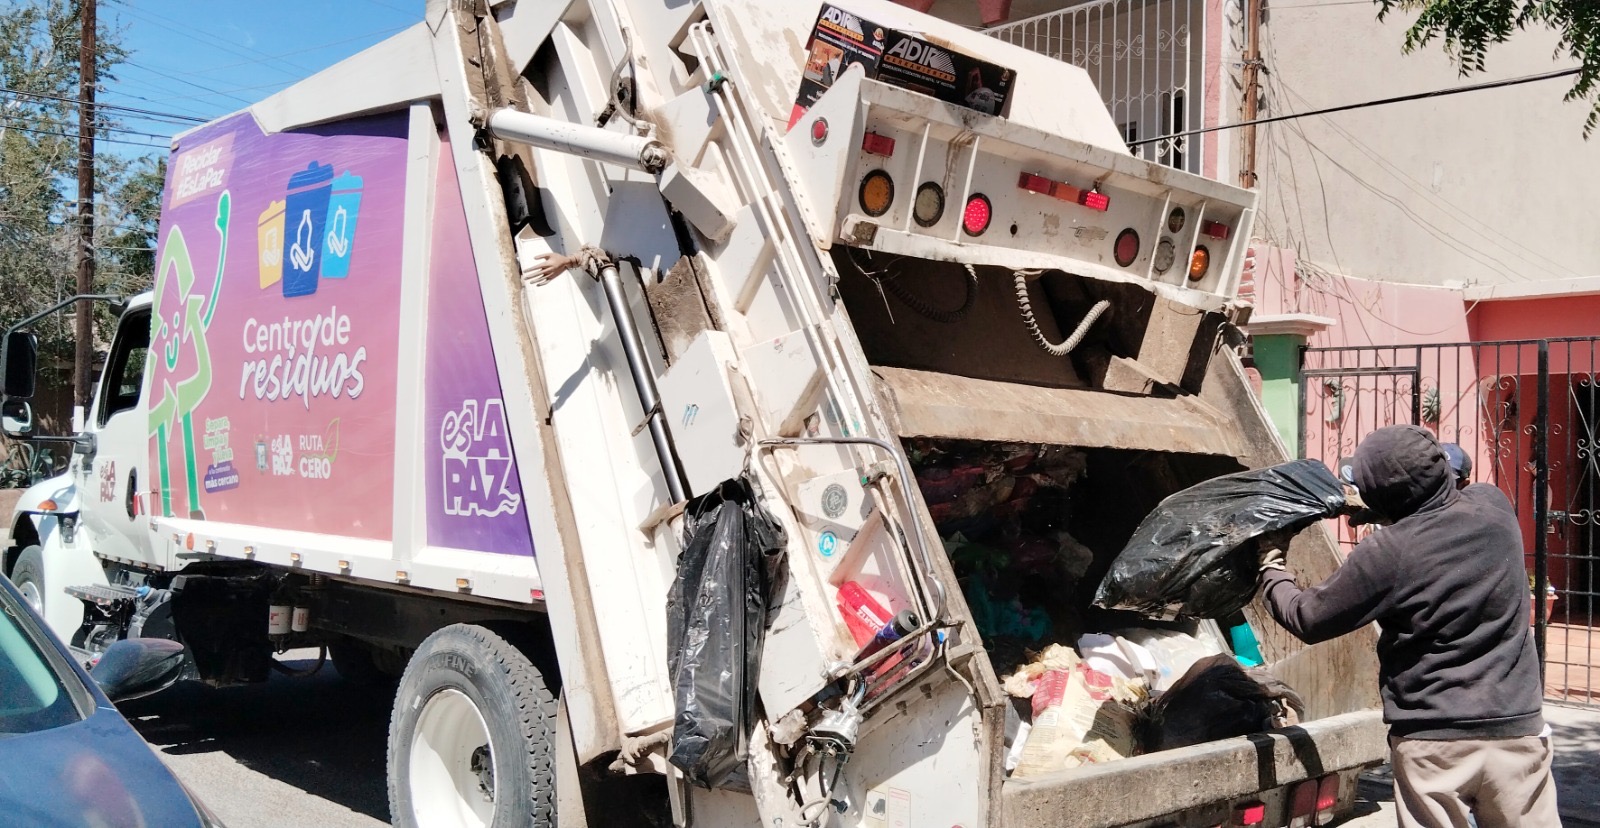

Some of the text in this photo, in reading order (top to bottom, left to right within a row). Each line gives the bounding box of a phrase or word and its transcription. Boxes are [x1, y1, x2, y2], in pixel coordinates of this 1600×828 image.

[821, 6, 864, 36] ADIR
[887, 37, 956, 76] ADIR
[181, 146, 223, 176] Reciclar
[176, 168, 225, 200] #EsLaPaz
[243, 305, 351, 354] Centro de
[239, 313, 367, 411] residuos
[300, 435, 323, 451] RUTA
[218, 474, 239, 486] cercano
[272, 455, 296, 475] PAZ
[300, 457, 331, 479] CERO
[100, 482, 116, 502] PAZ
[443, 457, 519, 517] PAZ
[855, 608, 882, 633] UARTZ
